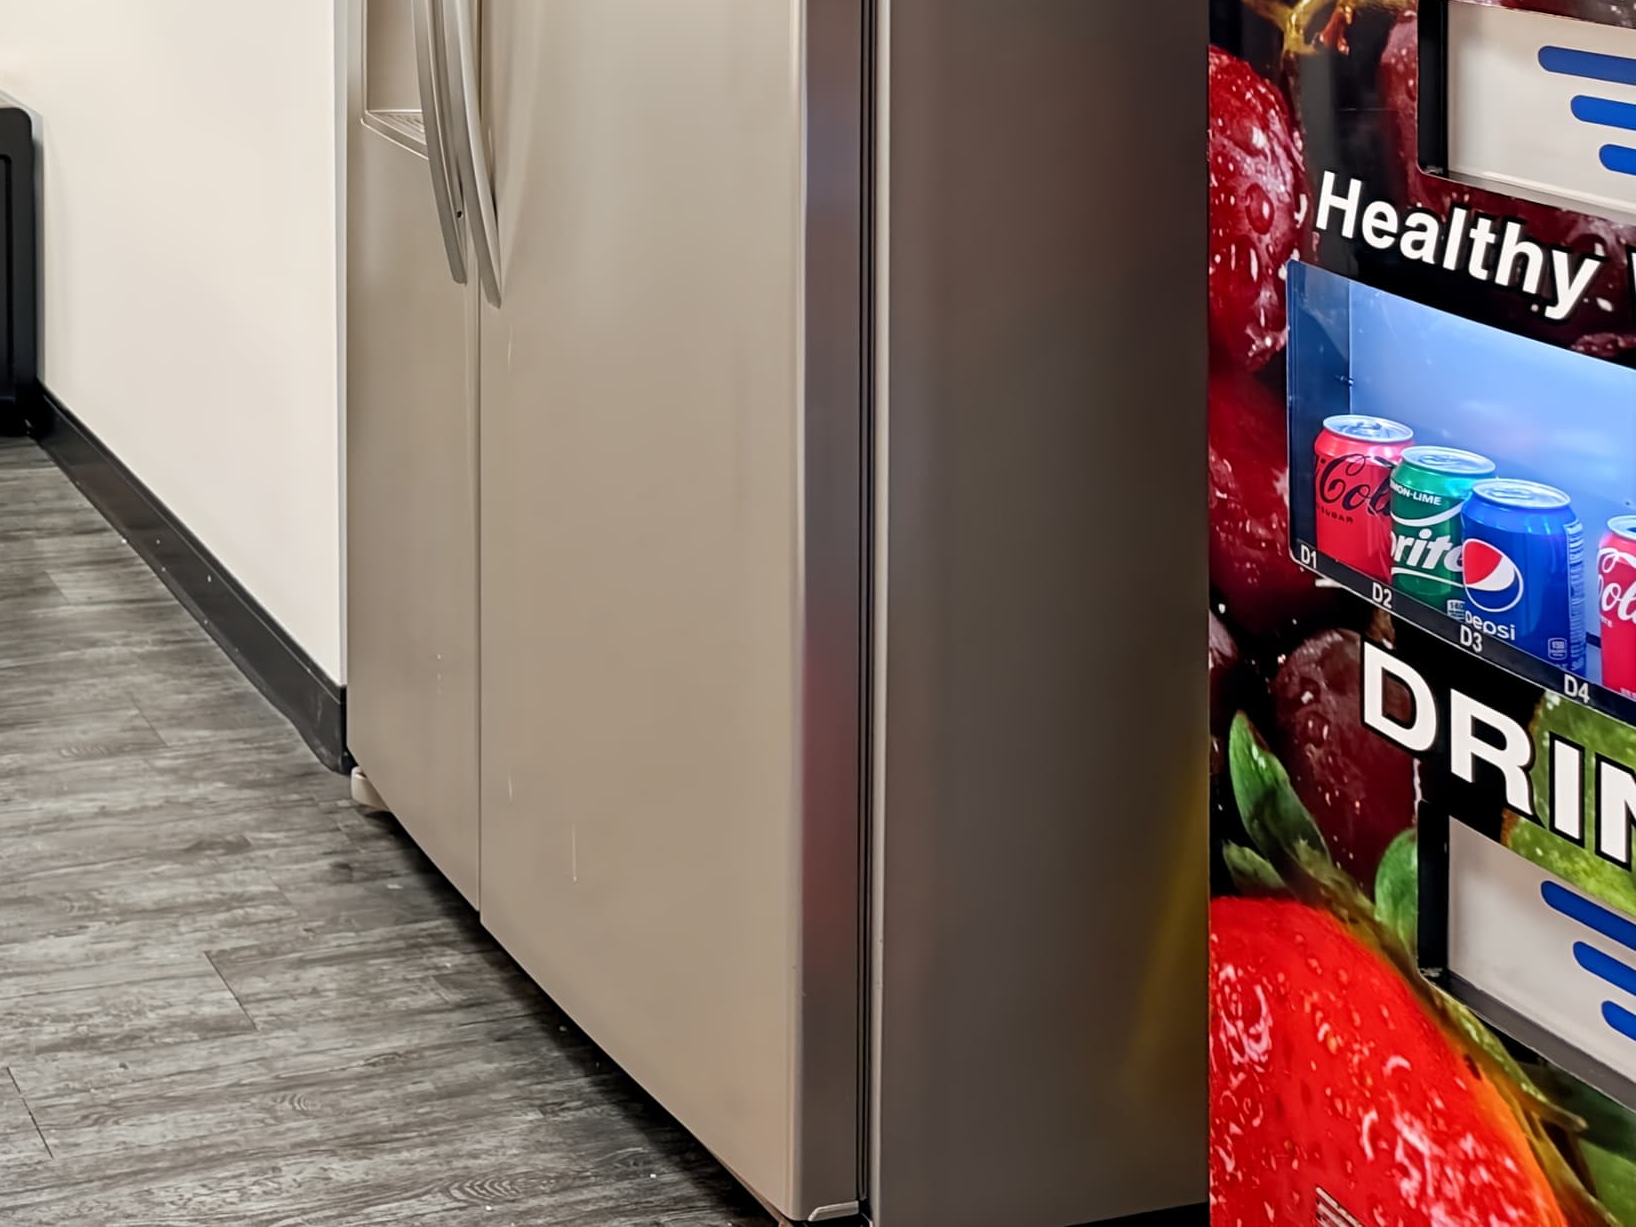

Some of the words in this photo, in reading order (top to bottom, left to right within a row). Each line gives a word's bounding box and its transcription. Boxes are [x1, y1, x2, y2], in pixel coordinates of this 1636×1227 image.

[1316, 170, 1601, 320] Healthy
[1300, 544, 1317, 569] D1
[1390, 528, 1462, 572] rite
[1372, 582, 1393, 609] D2
[1459, 625, 1483, 653] D3
[1564, 674, 1590, 704] D4
